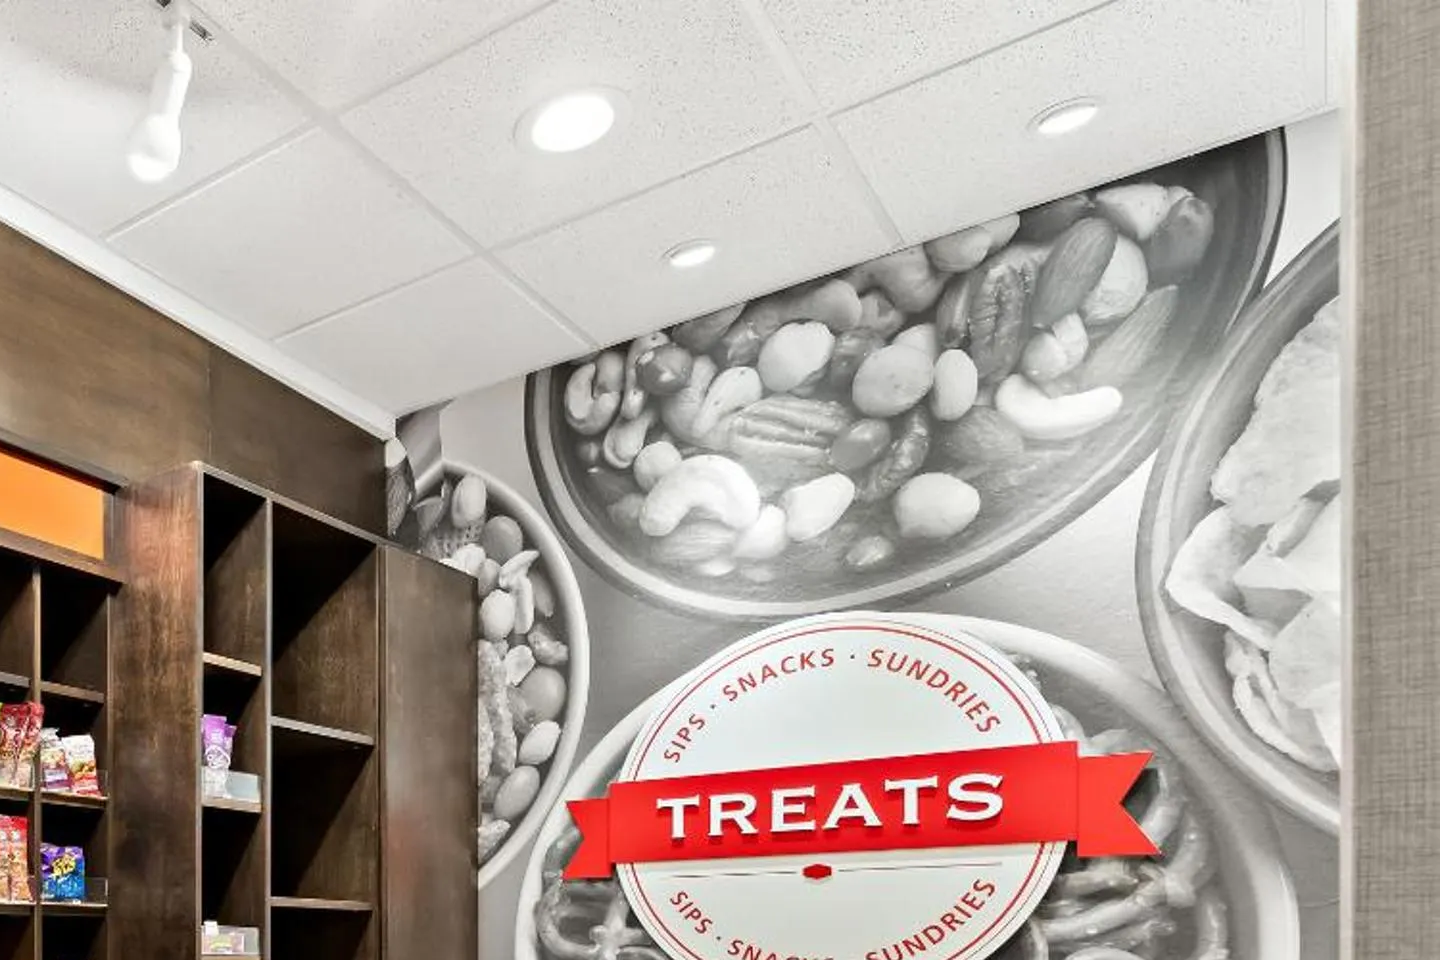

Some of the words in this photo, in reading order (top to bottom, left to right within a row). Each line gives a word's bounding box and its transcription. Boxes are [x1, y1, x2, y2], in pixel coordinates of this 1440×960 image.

[663, 713, 706, 764] SIPS
[722, 647, 835, 702] SNACKS
[866, 648, 1001, 733] SUNDRIES
[656, 772, 1005, 841] TREATS
[669, 890, 714, 935] SIPS
